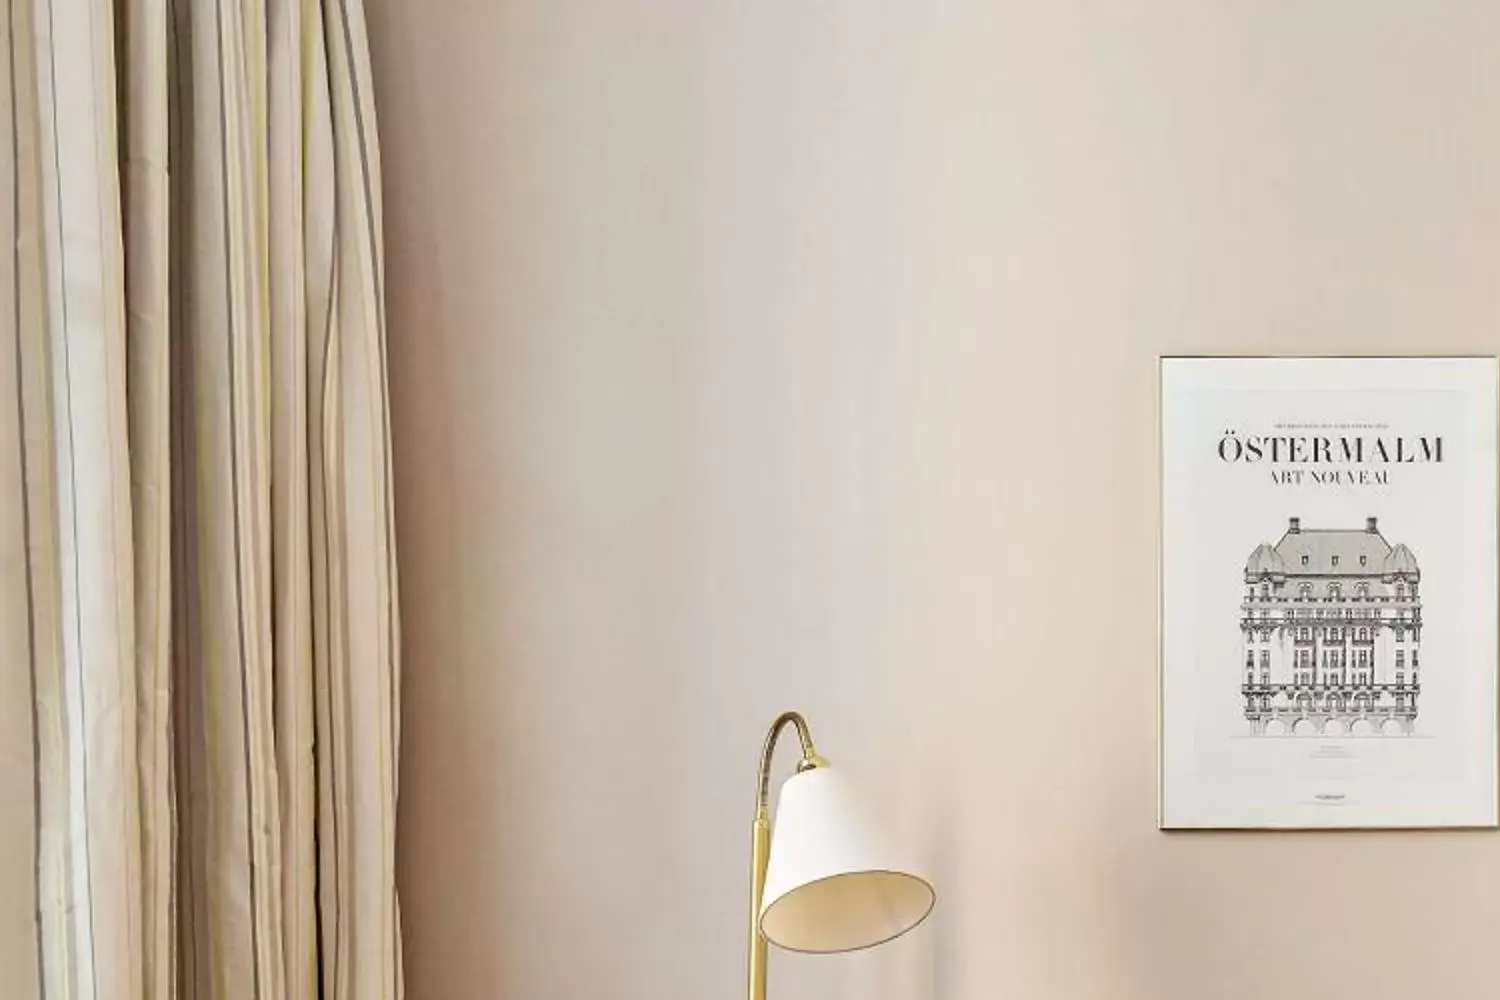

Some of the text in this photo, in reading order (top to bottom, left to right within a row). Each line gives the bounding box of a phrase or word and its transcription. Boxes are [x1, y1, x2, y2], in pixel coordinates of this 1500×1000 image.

[1217, 429, 1443, 464] ÖSTERMALM
[1271, 470, 1390, 485] ART NOUVEAU
